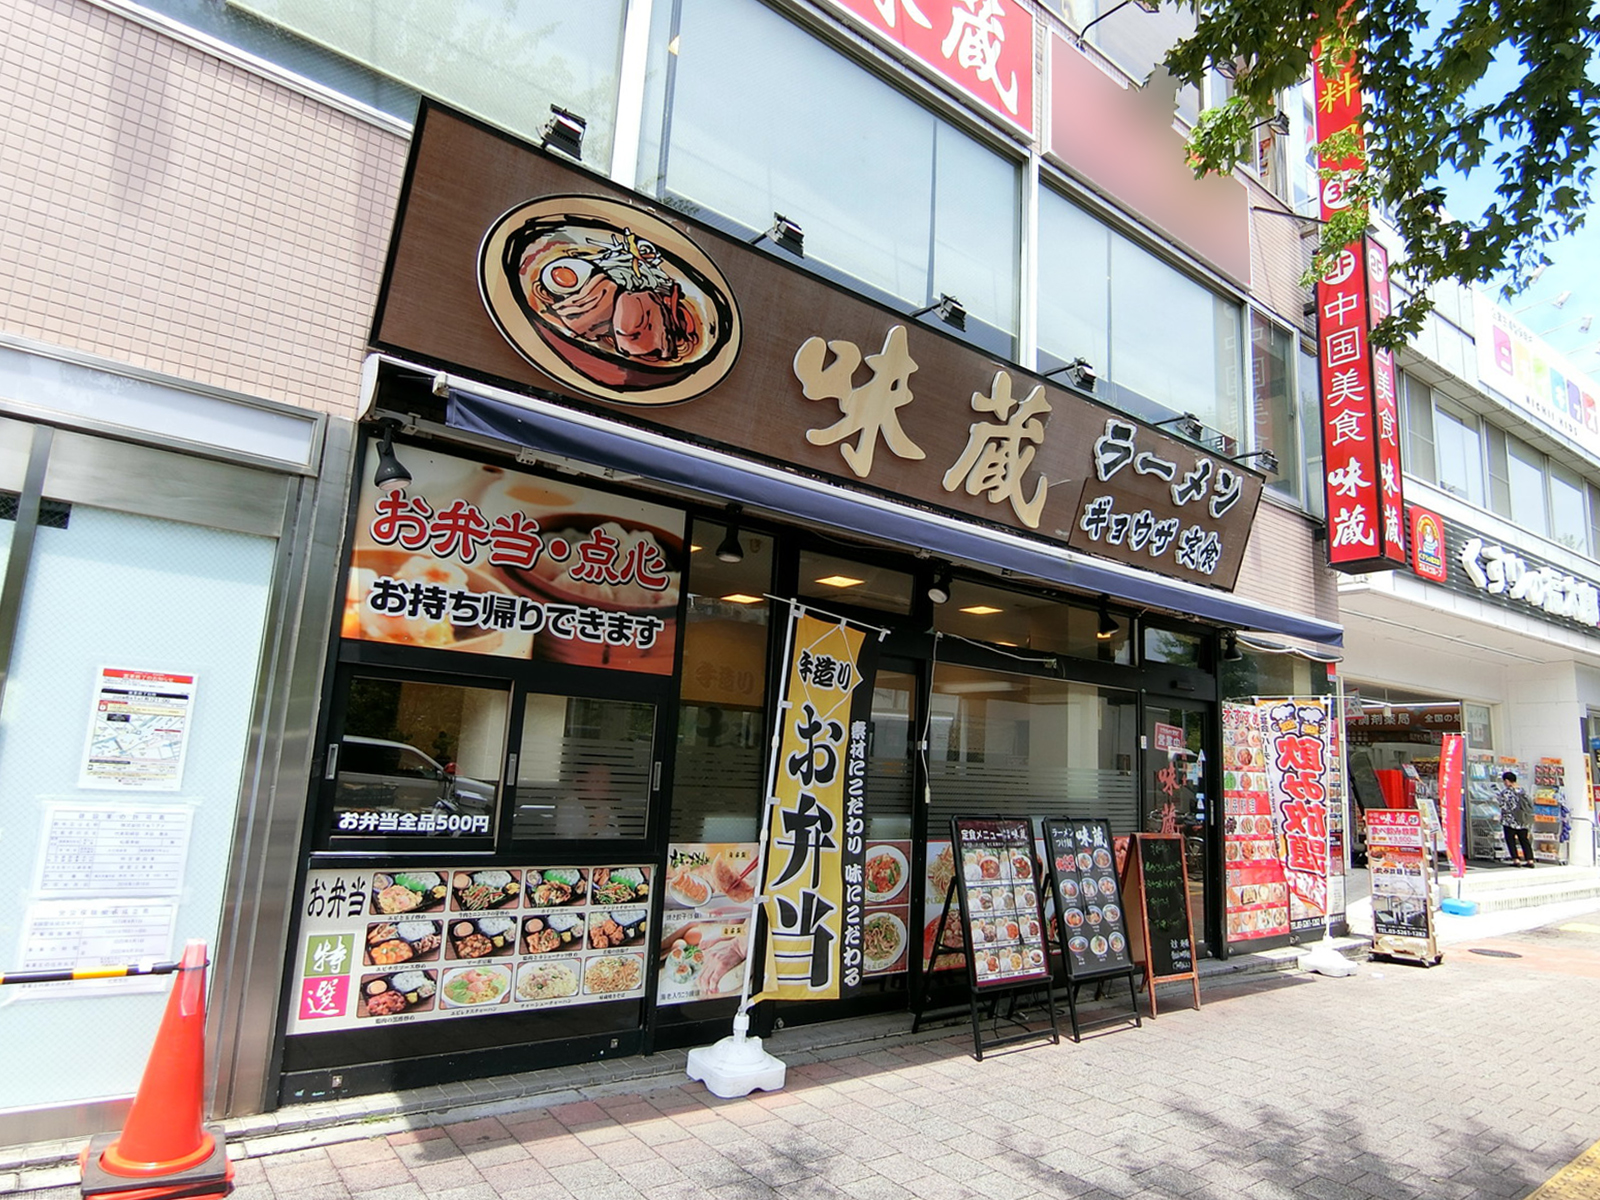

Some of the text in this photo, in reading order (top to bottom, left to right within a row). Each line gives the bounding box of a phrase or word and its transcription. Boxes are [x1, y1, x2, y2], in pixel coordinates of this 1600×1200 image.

[793, 325, 1052, 529] 味蔵
[1324, 293, 1375, 548] 中国美食 味蔵
[1093, 418, 1243, 519] ラーメン
[370, 488, 670, 591] お弁当・点心
[1080, 495, 1223, 575] ギョウザ 定食
[369, 577, 666, 649] お持ち帰りできます
[797, 648, 852, 692] 手造り
[338, 811, 490, 833] お弁当全品500円
[768, 701, 846, 992] お弁当
[843, 720, 868, 988] 素材にこだわり 味にこだわる
[1075, 825, 1109, 849] 味蔵
[306, 875, 367, 919] お弁当
